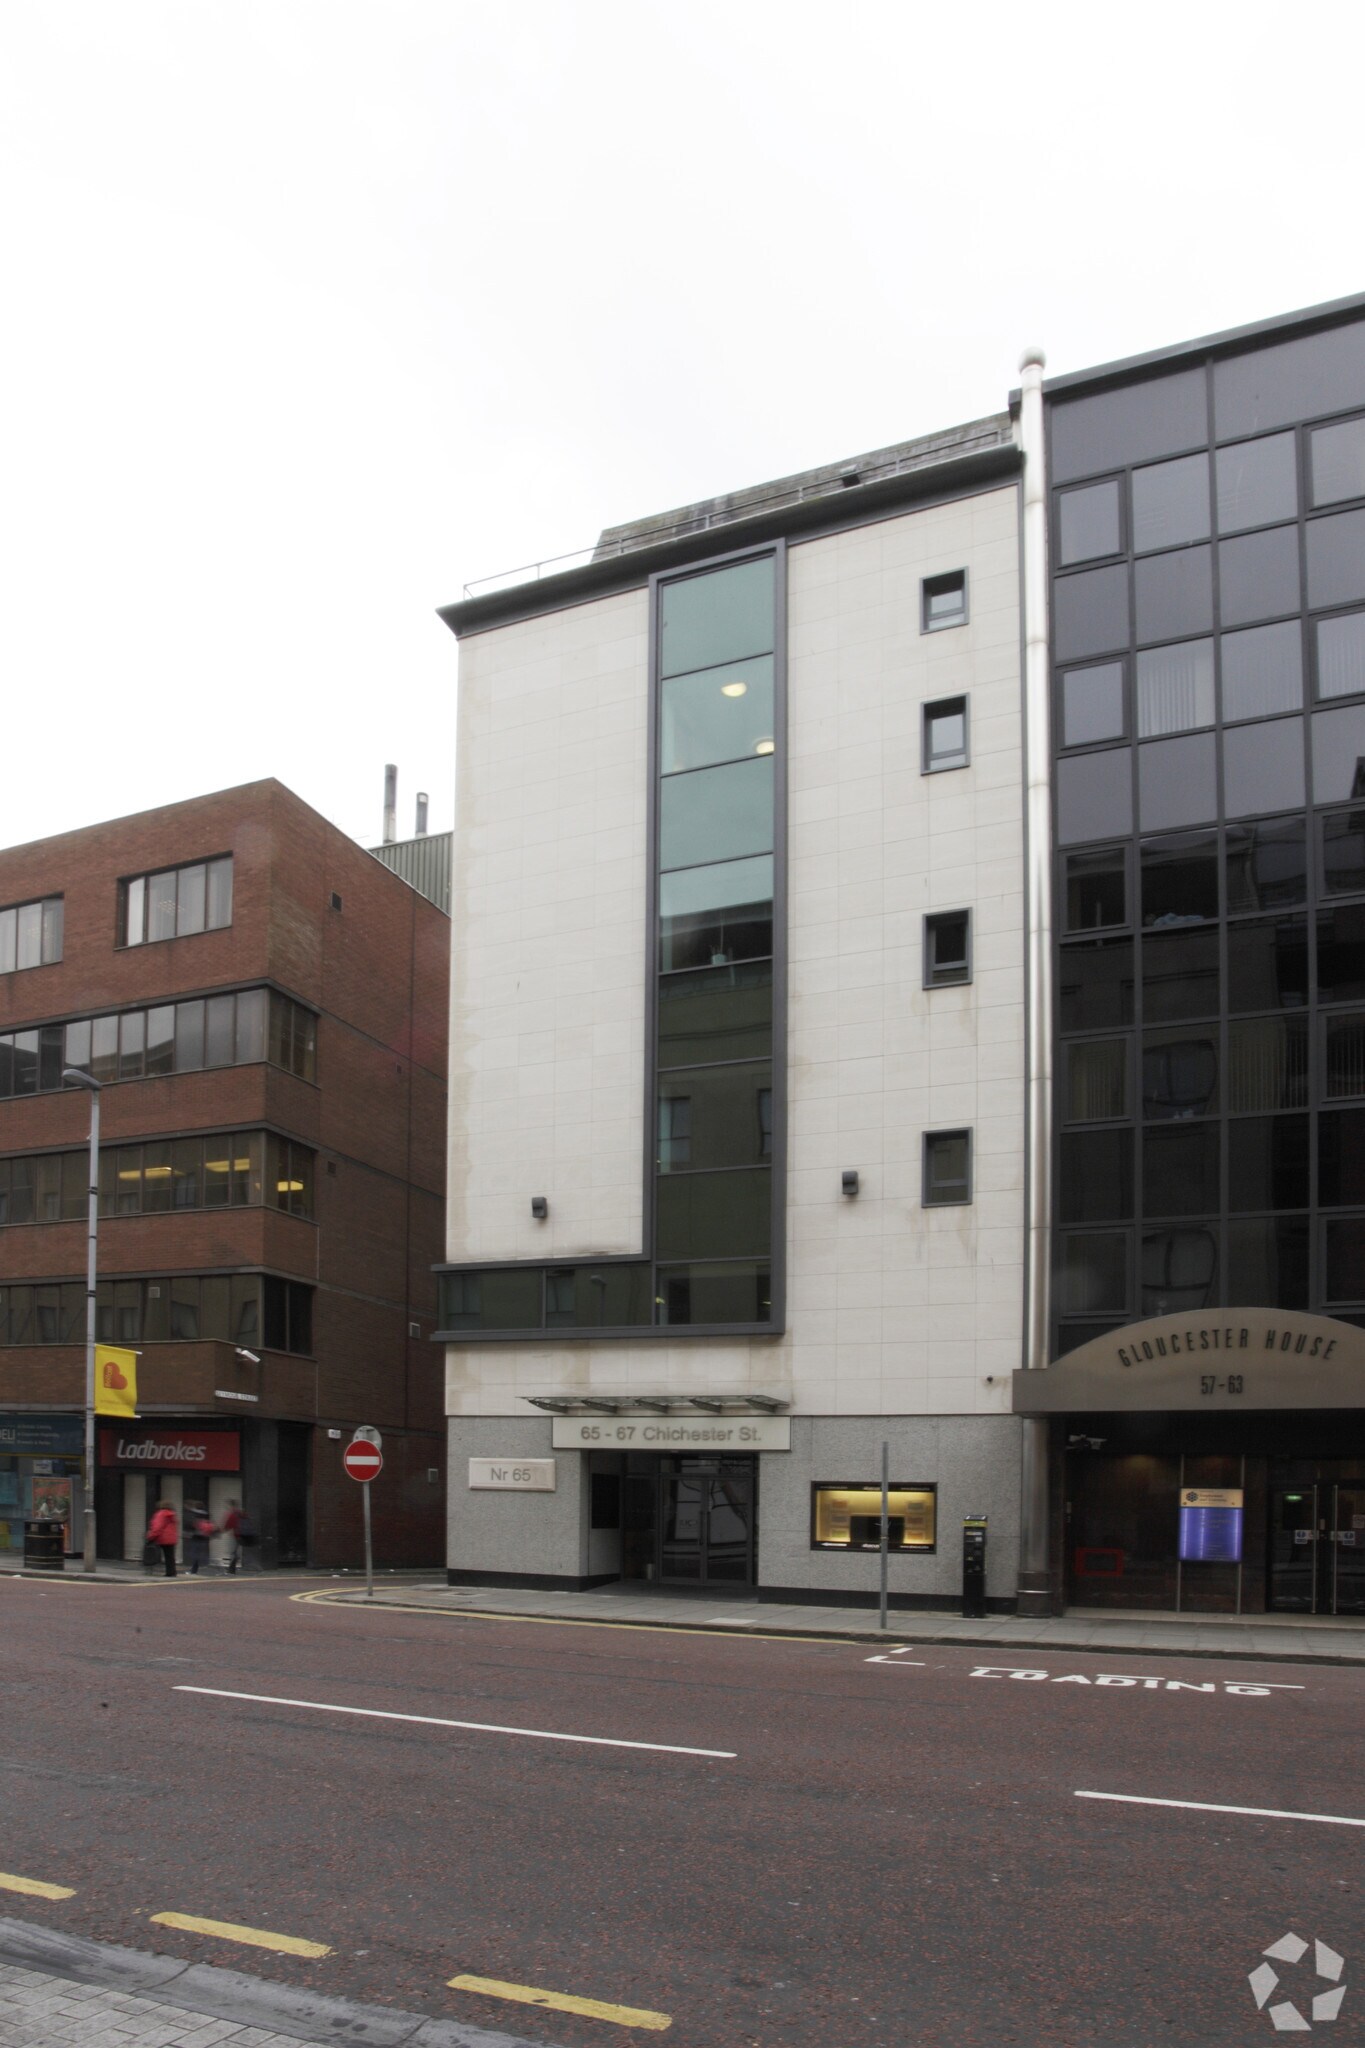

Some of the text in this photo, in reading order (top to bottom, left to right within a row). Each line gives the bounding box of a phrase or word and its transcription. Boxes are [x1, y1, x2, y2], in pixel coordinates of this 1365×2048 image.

[1117, 1328, 1338, 1367] GLOUCESTER HOUSE
[580, 1426, 601, 1440] 65
[616, 1426, 636, 1440] 67
[642, 1426, 734, 1441] Chichester
[739, 1426, 762, 1441] St.
[117, 1439, 207, 1461] Ladbrokes
[491, 1467, 531, 1481] Nr 65
[968, 1668, 1272, 1696] LOADING
